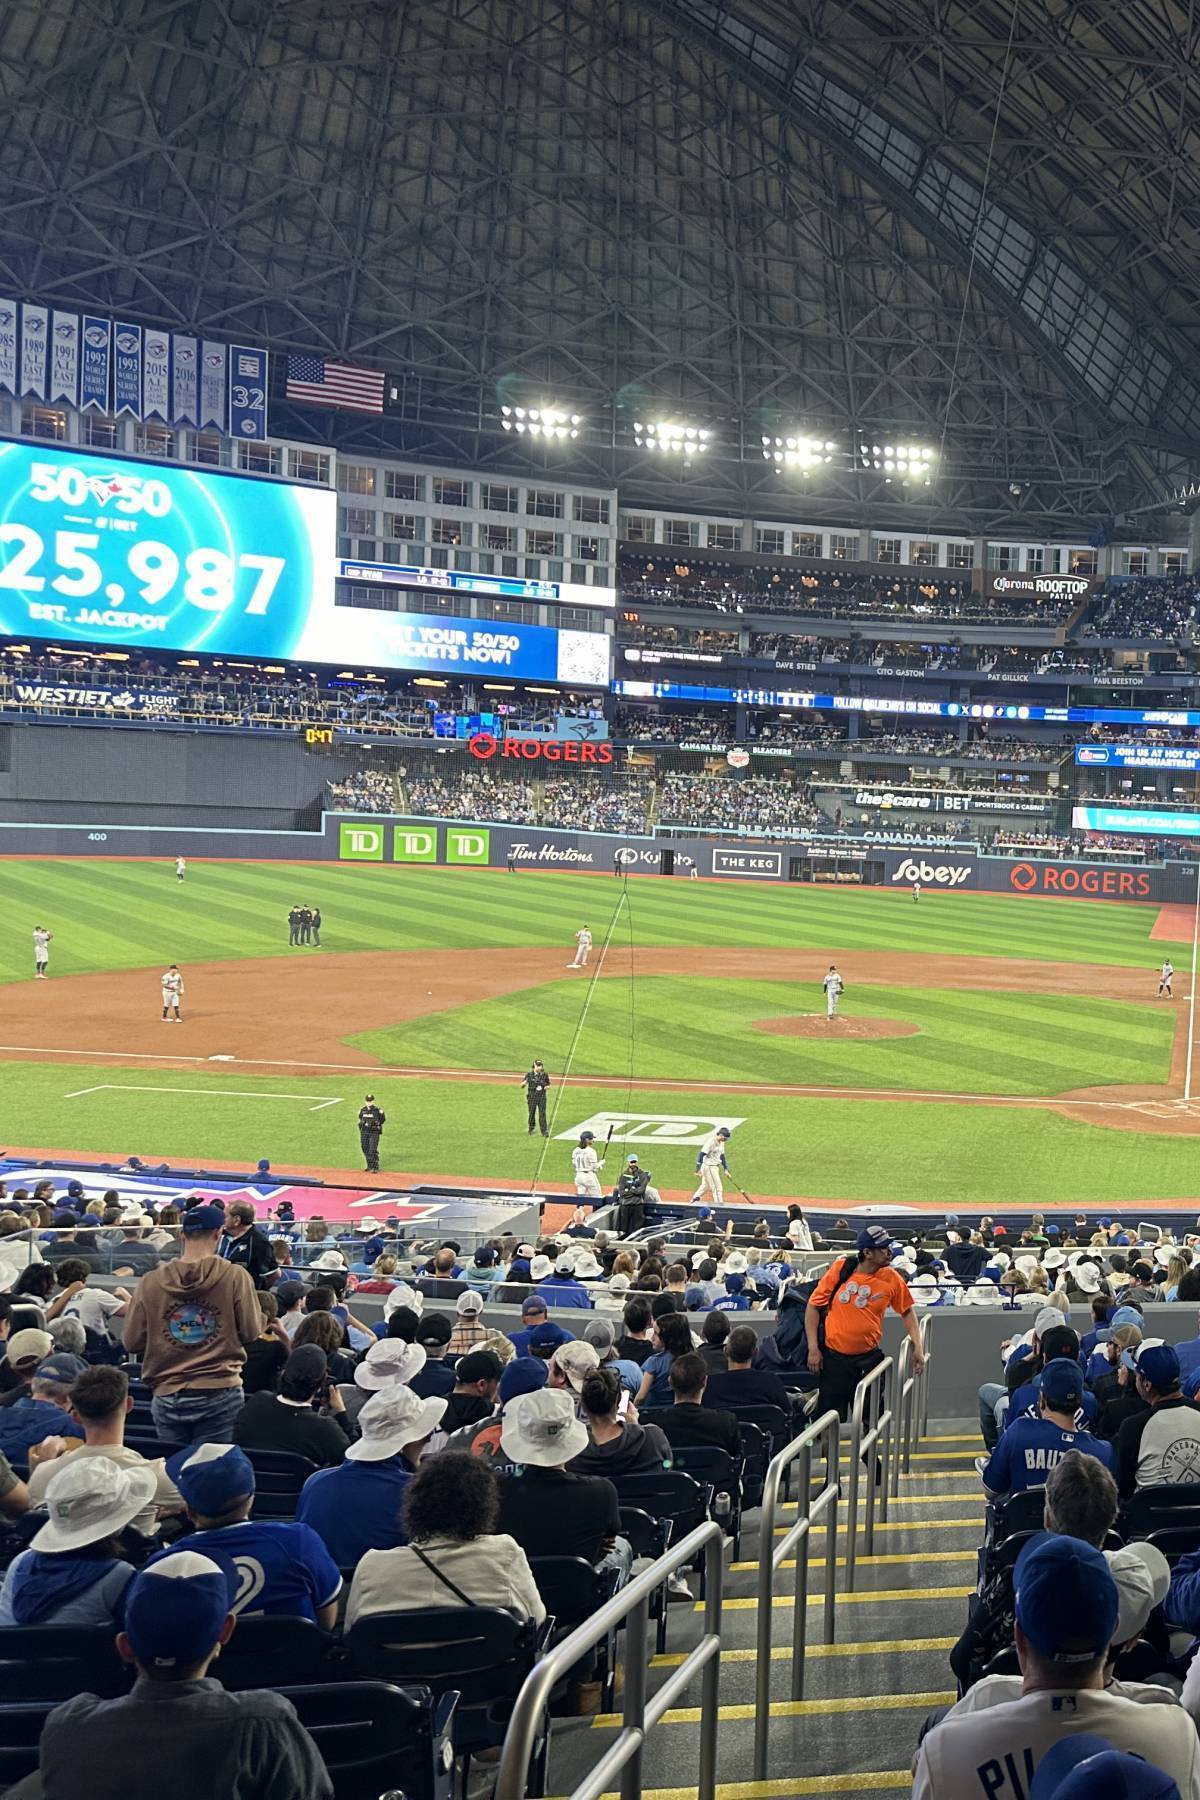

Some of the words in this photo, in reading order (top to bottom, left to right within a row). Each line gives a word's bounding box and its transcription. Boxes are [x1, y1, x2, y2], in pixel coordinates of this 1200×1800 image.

[85, 350, 106, 366] 1992
[118, 356, 138, 372] 1993
[146, 361, 168, 377] 2015
[175, 367, 196, 382] 2016
[232, 385, 265, 411] 32
[29, 462, 89, 507] 50
[0, 522, 286, 616] 25,987
[993, 577, 1034, 592] Corona
[1036, 580, 1088, 594] ROOFTOP
[29, 602, 72, 623] EST.
[75, 608, 170, 632] JACKPOT
[418, 627, 468, 646] YOUR
[473, 632, 520, 651] 50/50
[463, 647, 511, 665] NOW!
[776, 661, 794, 669] DAVE
[797, 663, 816, 671] STIEB
[877, 668, 893, 676] CITO
[896, 669, 925, 677] GASTON
[987, 673, 1001, 681] PAT
[1002, 674, 1029, 682] GILLICK
[1114, 677, 1144, 685] BEESTON
[139, 695, 179, 706] FLIGHT
[833, 696, 862, 708] FOLLOW
[917, 702, 942, 713] SOCIAL
[503, 741, 612, 763] ROGERS
[679, 742, 710, 750] CANADA
[752, 746, 791, 755] BLEACHERS
[1115, 748, 1135, 757] JOIN
[1137, 749, 1149, 758] US
[1151, 750, 1163, 758] AT
[1165, 750, 1184, 759] HOT
[1124, 757, 1195, 768] HEADQUARTERS!
[856, 792, 931, 807] theScore
[944, 797, 971, 810] BET
[88, 833, 107, 841] 400
[345, 830, 379, 852] TD
[398, 832, 433, 855] TD
[452, 834, 485, 857] TD
[511, 843, 539, 861] Tim
[539, 847, 594, 863] Hortons
[640, 850, 693, 866] Kuta
[721, 857, 745, 867] THE
[749, 859, 774, 868] KEG
[892, 858, 972, 886] Sobeys
[1181, 867, 1194, 876] 328
[1043, 867, 1150, 896] ROGERS
